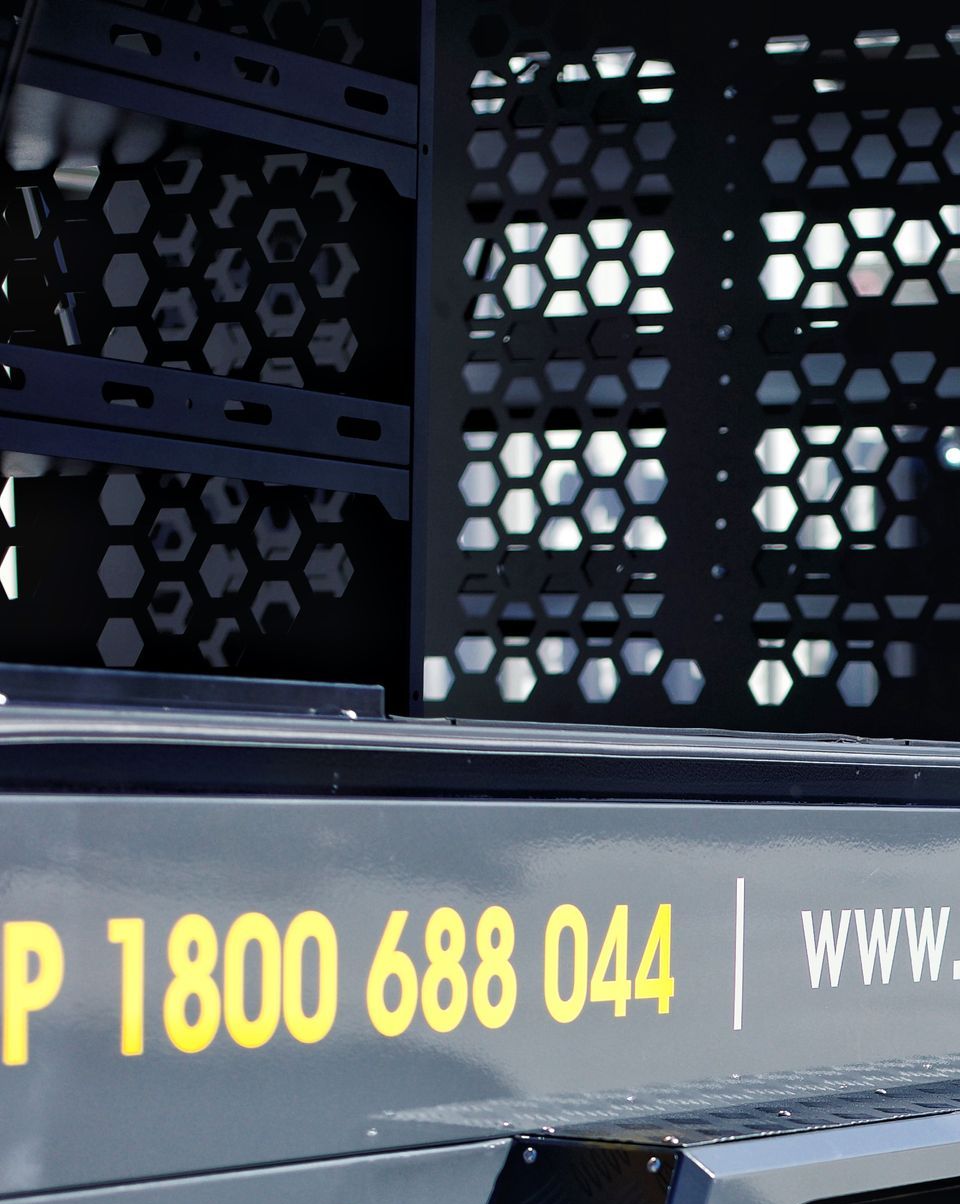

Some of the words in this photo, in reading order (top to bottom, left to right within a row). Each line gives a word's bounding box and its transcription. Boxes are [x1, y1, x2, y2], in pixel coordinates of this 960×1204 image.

[2, 921, 64, 1066] P
[107, 911, 338, 1056] 1800
[366, 906, 518, 1037] 688
[543, 904, 675, 1023] 044
